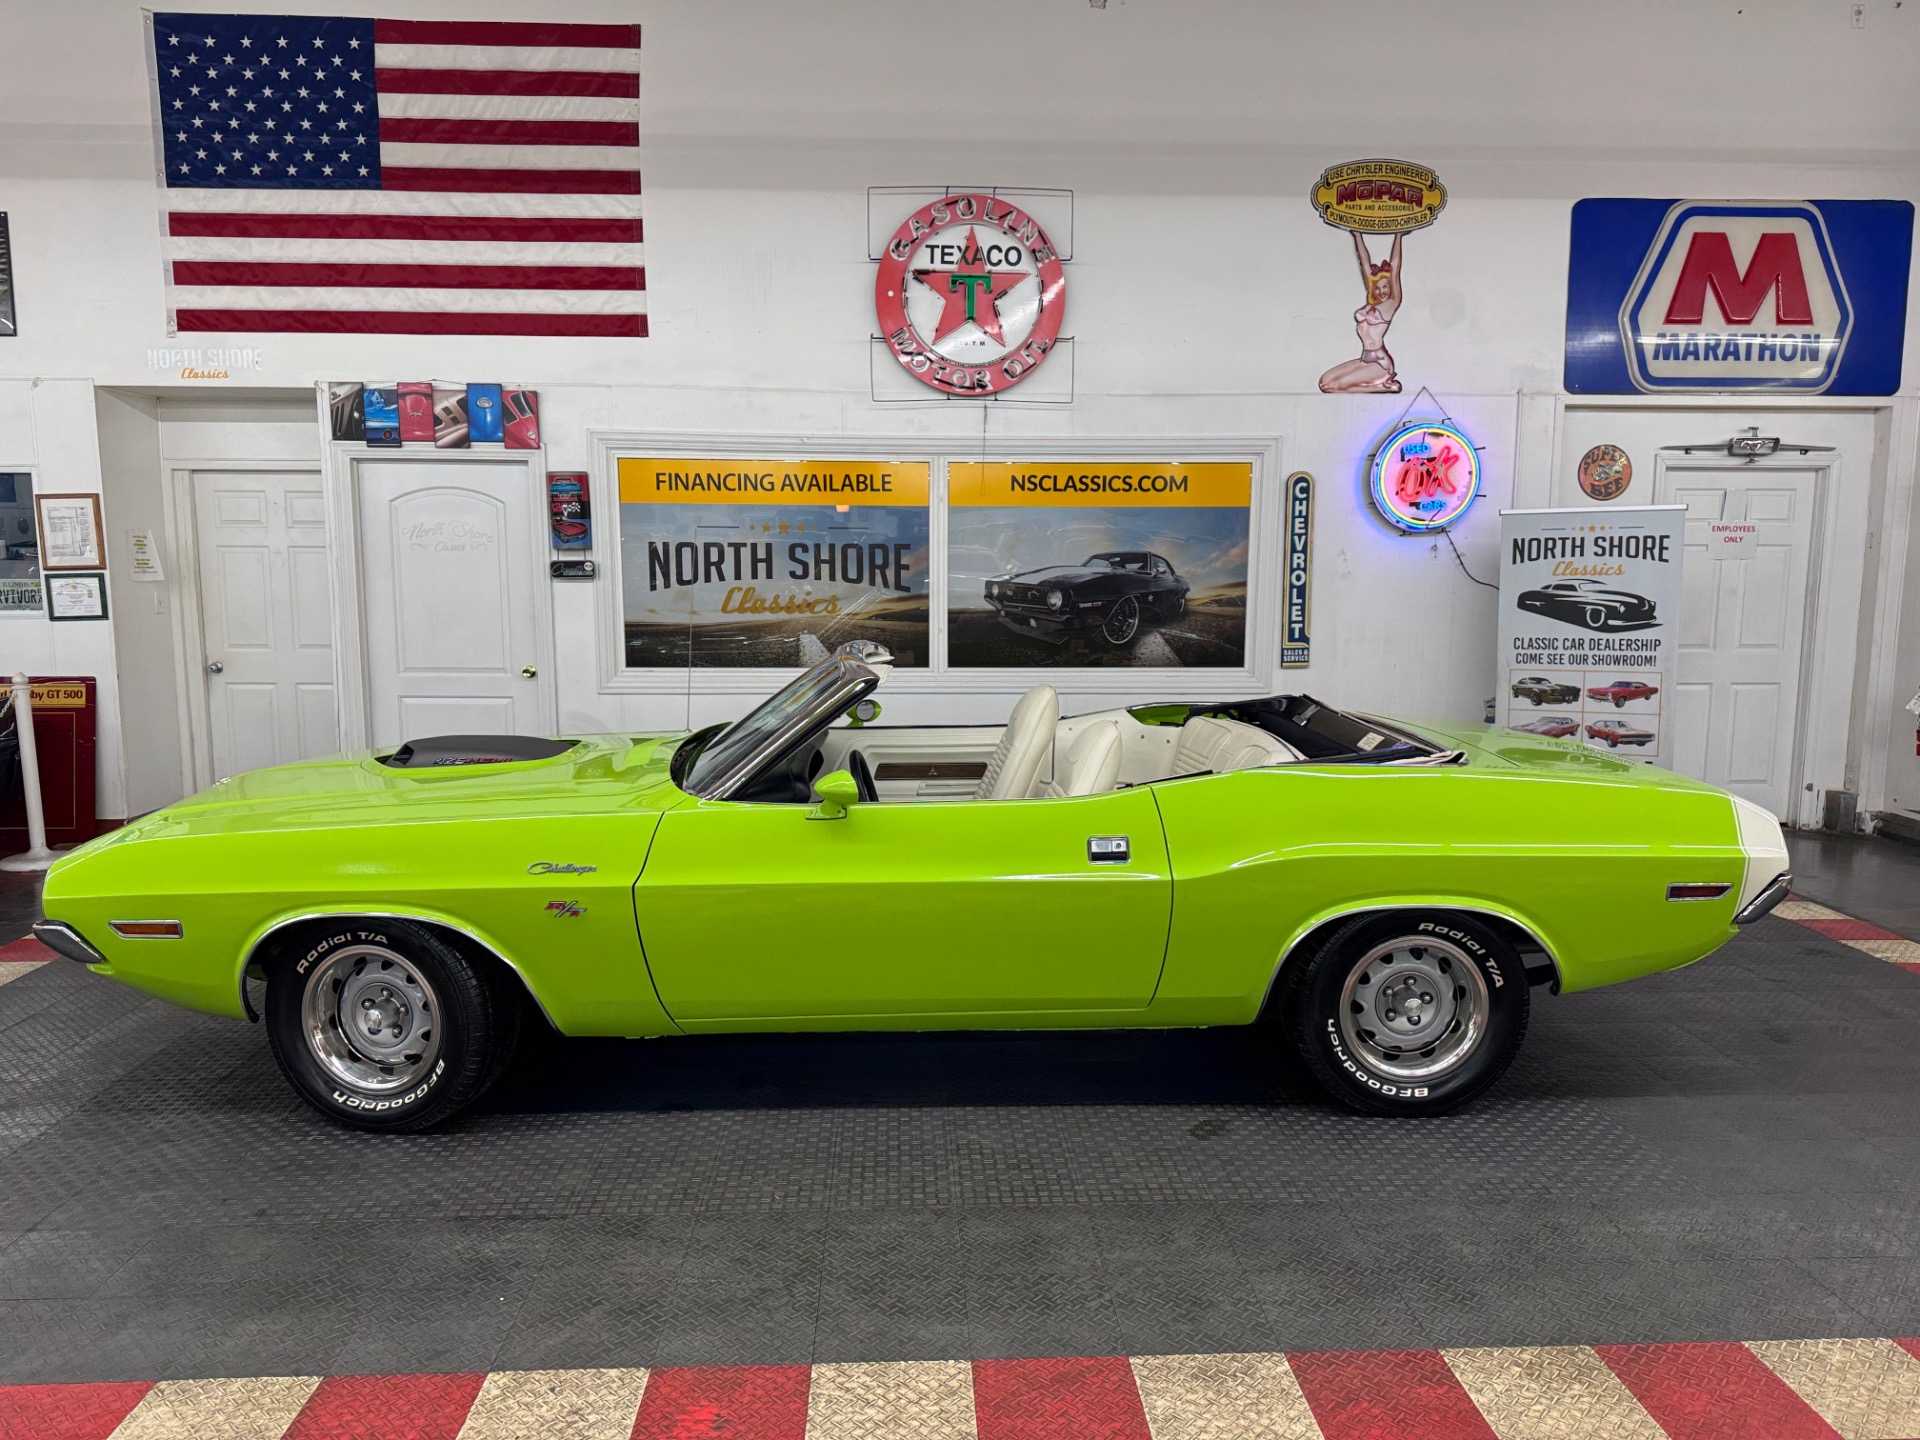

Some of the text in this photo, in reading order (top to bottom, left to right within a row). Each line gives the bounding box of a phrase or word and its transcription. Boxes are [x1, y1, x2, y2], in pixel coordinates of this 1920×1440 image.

[1330, 164, 1429, 182] USE CHRYSLER ENGINEERED
[1336, 179, 1424, 208] MOPAR
[1345, 203, 1362, 211] PARTS
[1377, 204, 1415, 212] ACCESSORIES
[889, 196, 1055, 268] GASOLINE
[925, 244, 1022, 267] TEXACO
[1662, 231, 1814, 326] M
[950, 273, 992, 321] T
[1652, 332, 1820, 362] MARATHON
[147, 348, 263, 371] NORTH SHORE
[890, 327, 1051, 392] MOTOR OIL
[180, 367, 230, 379] Classics
[1403, 443, 1430, 454] USED
[1582, 445, 1628, 476] SUPER
[655, 472, 893, 493] FINANCING AVAILABLE
[1010, 474, 1189, 493] NSCLASSICS.COM
[1396, 445, 1460, 503] OK
[1589, 477, 1624, 497] BEE
[1419, 500, 1447, 511] CARS
[401, 520, 495, 543] North Shore
[1711, 525, 1756, 534] EMPLOYEES
[1723, 535, 1744, 544] ONLY
[1291, 481, 1308, 640] CHEVROLET
[1512, 534, 1670, 565] NORTH SHORE
[648, 541, 911, 593] NORTH SHORE
[1552, 560, 1626, 577] Classics
[720, 586, 843, 615] Classics
[1513, 637, 1661, 652] CLASSIC CAR DEALERSHIP
[1515, 653, 1657, 667] COME SEE OUR SHOWROOM!
[47, 690, 62, 699] GT
[63, 690, 83, 699] 500
[527, 861, 597, 876] Challenger
[544, 900, 587, 918] R/T
[296, 931, 388, 974] Radial T/A
[1418, 922, 1504, 988] Radial T/A
[1327, 1019, 1429, 1097] BFGoodrich
[332, 1058, 446, 1111] BFGoodrich
